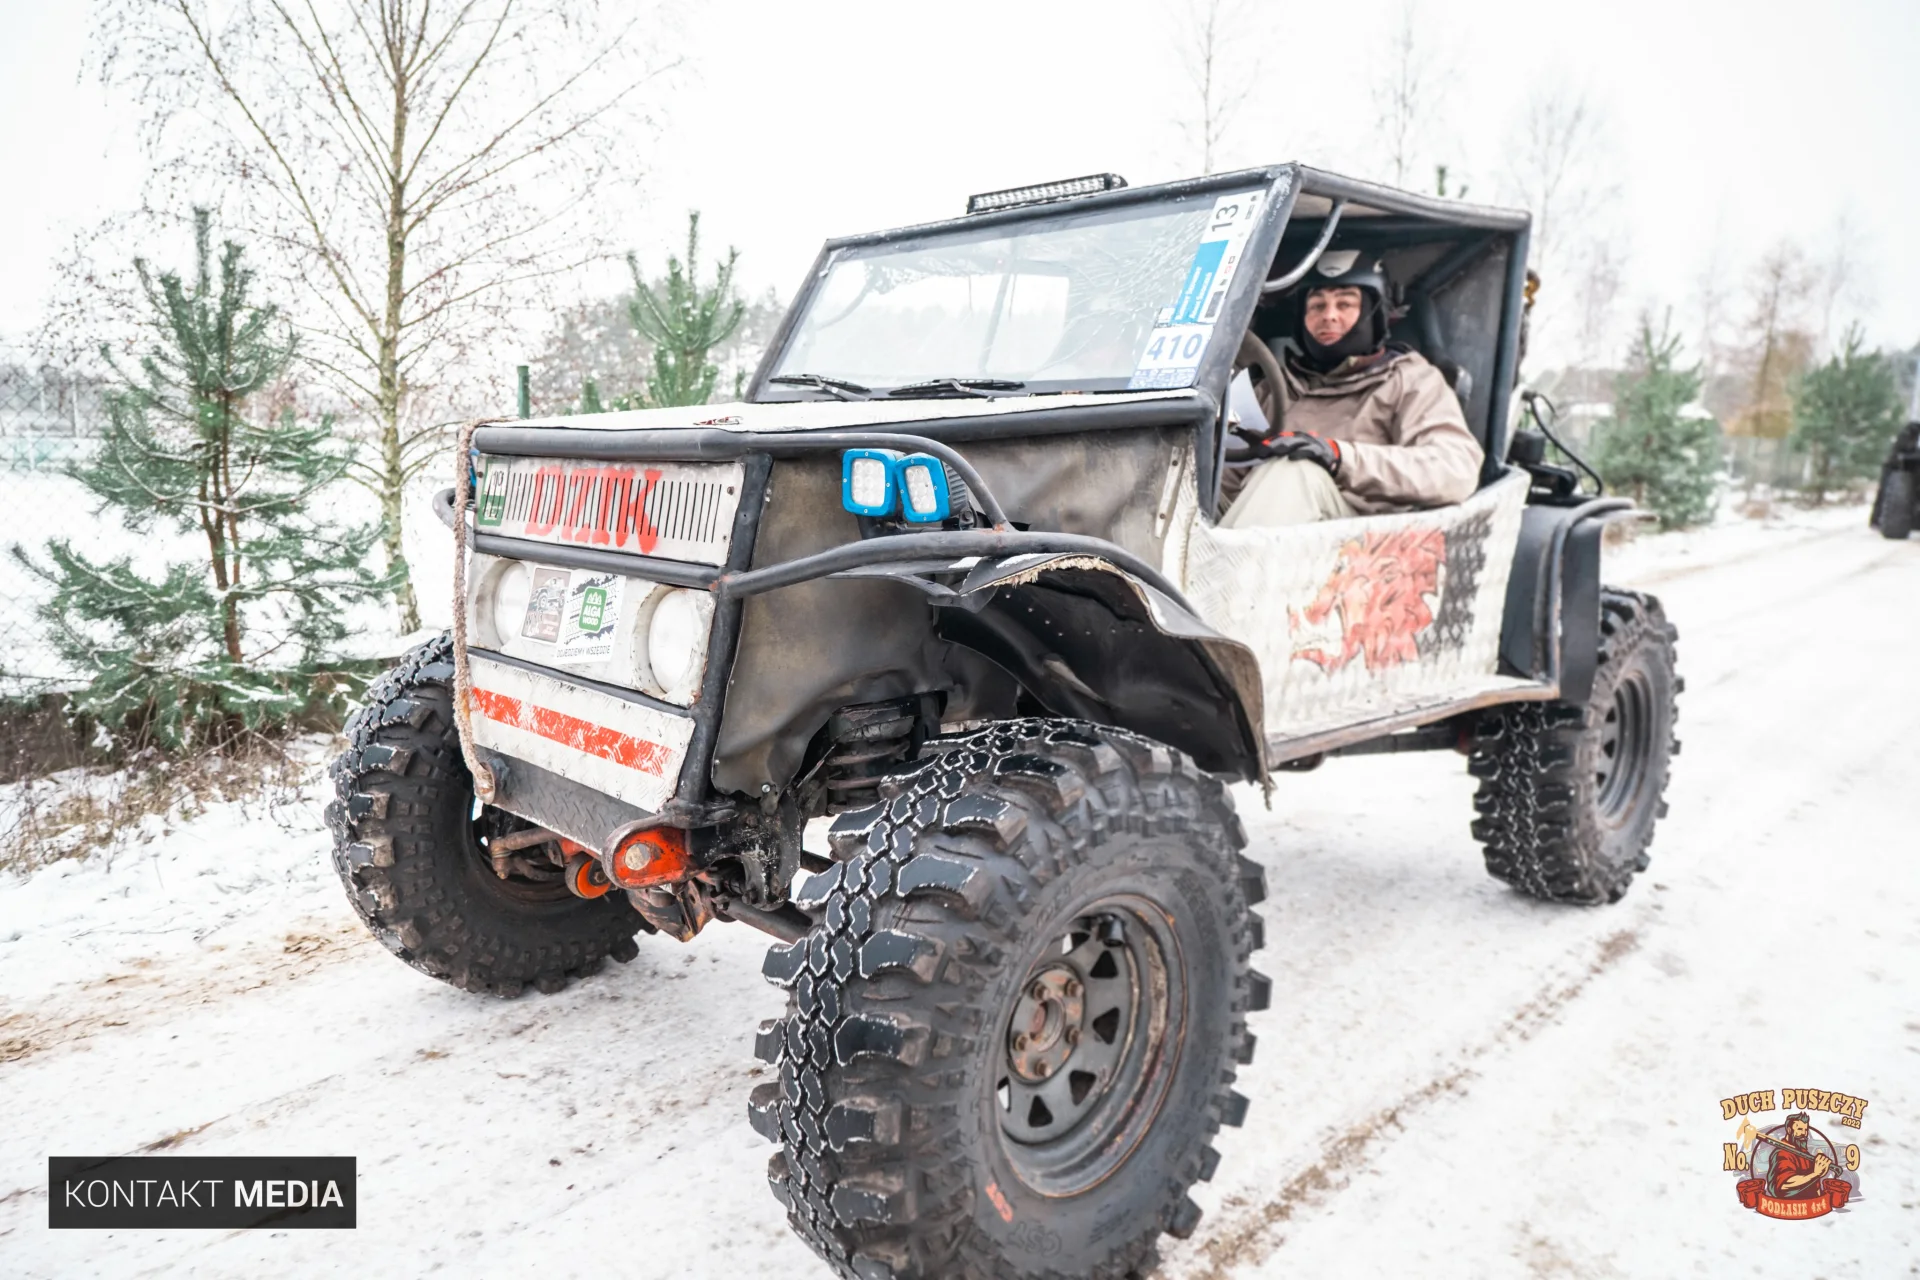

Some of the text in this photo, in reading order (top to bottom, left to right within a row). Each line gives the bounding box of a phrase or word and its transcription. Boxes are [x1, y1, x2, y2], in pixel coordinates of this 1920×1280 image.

[1212, 204, 1239, 232] 13
[1147, 333, 1203, 361] 410
[524, 465, 663, 556] DZIK
[582, 604, 602, 618] ALGA
[582, 616, 599, 626] WOOD
